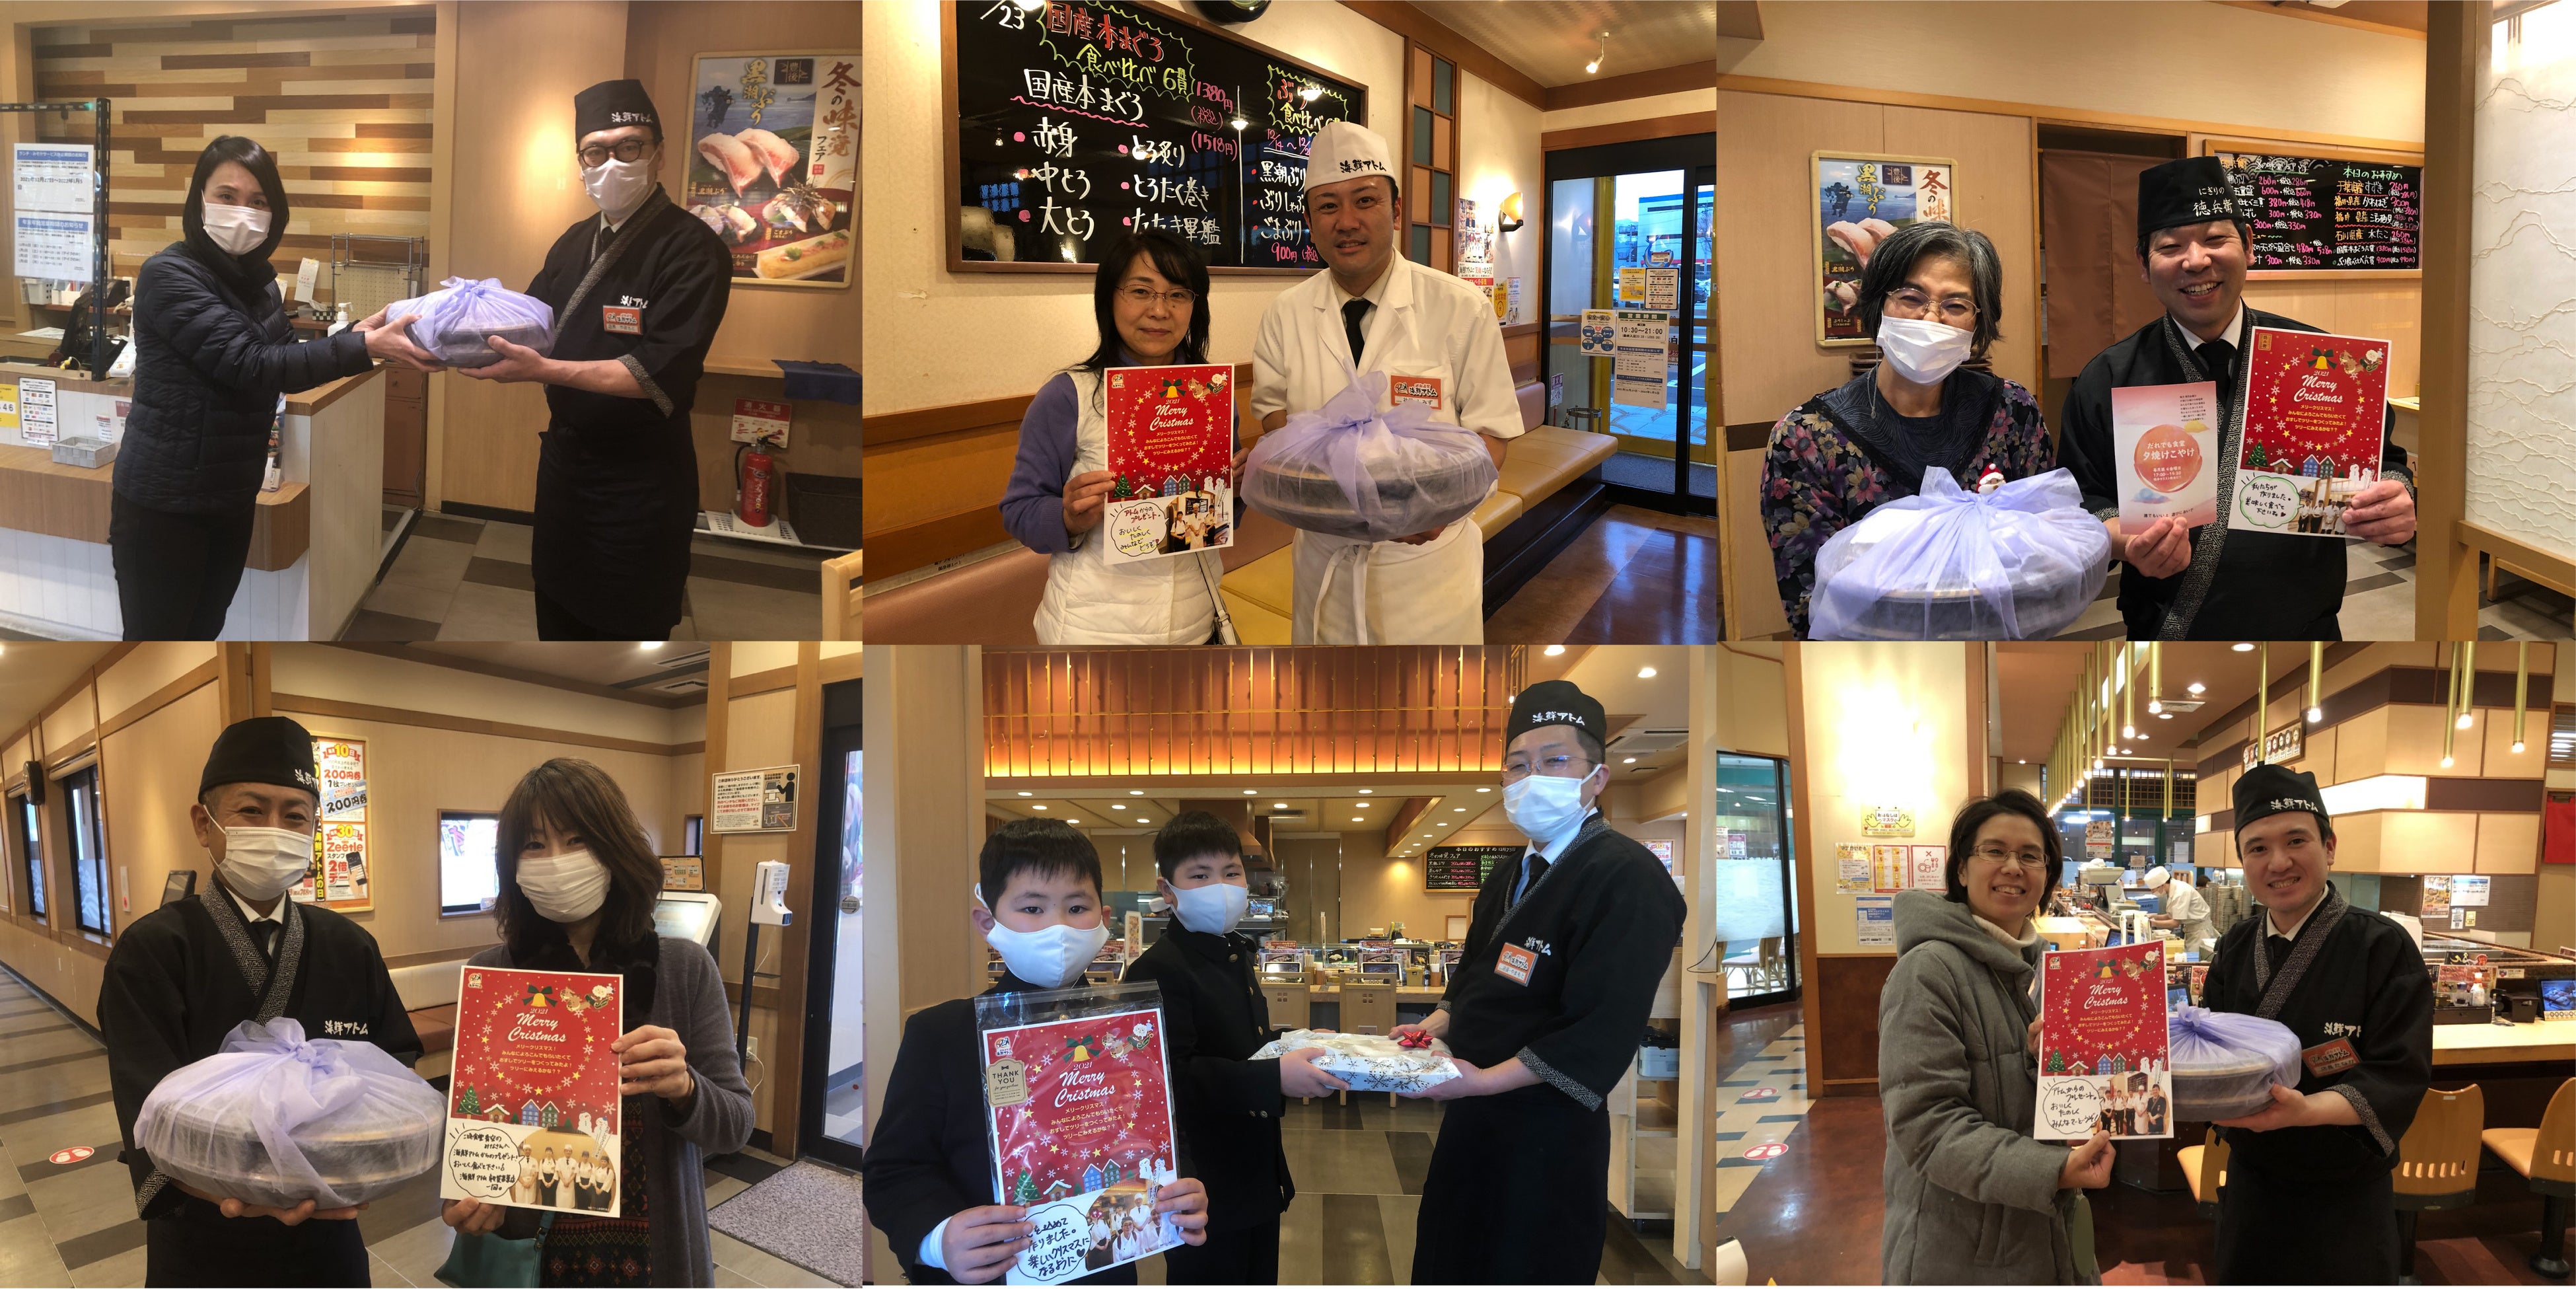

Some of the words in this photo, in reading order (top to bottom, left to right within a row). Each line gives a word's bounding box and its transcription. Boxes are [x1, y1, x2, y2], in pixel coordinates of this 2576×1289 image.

[1046, 1, 1164, 61] 国産本まぐろ
[1076, 44, 1157, 84] 食べ比べ
[1024, 68, 1144, 121] 国産本まぐろ
[1196, 81, 1233, 114] 1380円
[612, 112, 653, 123] 海鮮アトム
[1191, 106, 1223, 131] (税込)
[1280, 102, 1324, 129] 食べ比べ
[1031, 116, 1078, 157] 赤身
[814, 135, 827, 162] フェア
[1131, 135, 1186, 168] とろ炙り
[1191, 130, 1238, 161] (1518円)
[1340, 160, 1387, 174] 海鮮アトム
[2343, 165, 2402, 180] 本日のおすすめ
[1031, 161, 1091, 200] 中とろ
[1260, 161, 1306, 192] 黒潮ぶり
[1893, 167, 1901, 184] 豊後
[1133, 174, 1209, 212] とろたく巻き
[2199, 186, 2225, 196] にぎりの
[2193, 199, 2233, 217] 徳兵衛
[1038, 196, 1094, 241] 大とろ
[1260, 217, 1302, 246] ごまぶり
[2335, 229, 2364, 241] 石川県産
[2368, 229, 2388, 239] 水たこ
[1271, 242, 1297, 262] 900円
[2302, 375, 2337, 392] Merry
[1409, 387, 1438, 396] 海鮮アトム
[2294, 388, 2343, 403] Cristmas
[744, 400, 781, 412] 消火器
[1155, 404, 1188, 418] Merry
[1149, 416, 1194, 431] Cristmas
[2147, 440, 2186, 449] だれでも食堂
[2143, 448, 2195, 460] 夕焼けこやけ
[2251, 482, 2277, 491] 私たちが
[1124, 506, 1153, 517] アトムからの
[1119, 525, 1142, 536] おいしく
[1130, 530, 1151, 540] たのしく
[1120, 538, 1143, 550] みんなで
[1532, 711, 1585, 726] 海鮮アトム
[324, 770, 361, 780] 200円券
[326, 793, 367, 813] 200円券
[2270, 797, 2318, 813] 海鮮アトム
[326, 842, 363, 852] Zeetle
[328, 860, 347, 872] 2倍
[328, 873, 348, 884] デー
[2089, 984, 2122, 996] Merry
[2083, 996, 2129, 1010] Cristmas
[325, 1019, 369, 1036] 海鮮アトム
[516, 1013, 558, 1031] Merry
[508, 1027, 566, 1042] Cristmas
[1073, 1062, 1092, 1071] 2021
[1059, 1070, 1105, 1087] Merry
[1054, 1085, 1116, 1108] Cristmas
[2052, 1086, 2084, 1096] アトムからの
[1065, 1101, 1107, 1114] メリークリスマス！
[2059, 1108, 2079, 1117] たのしく
[1029, 1218, 1069, 1237] を込めて
[1028, 1237, 1090, 1269] 楽しいクリスマスに
[1038, 1256, 1077, 1277] なるように
